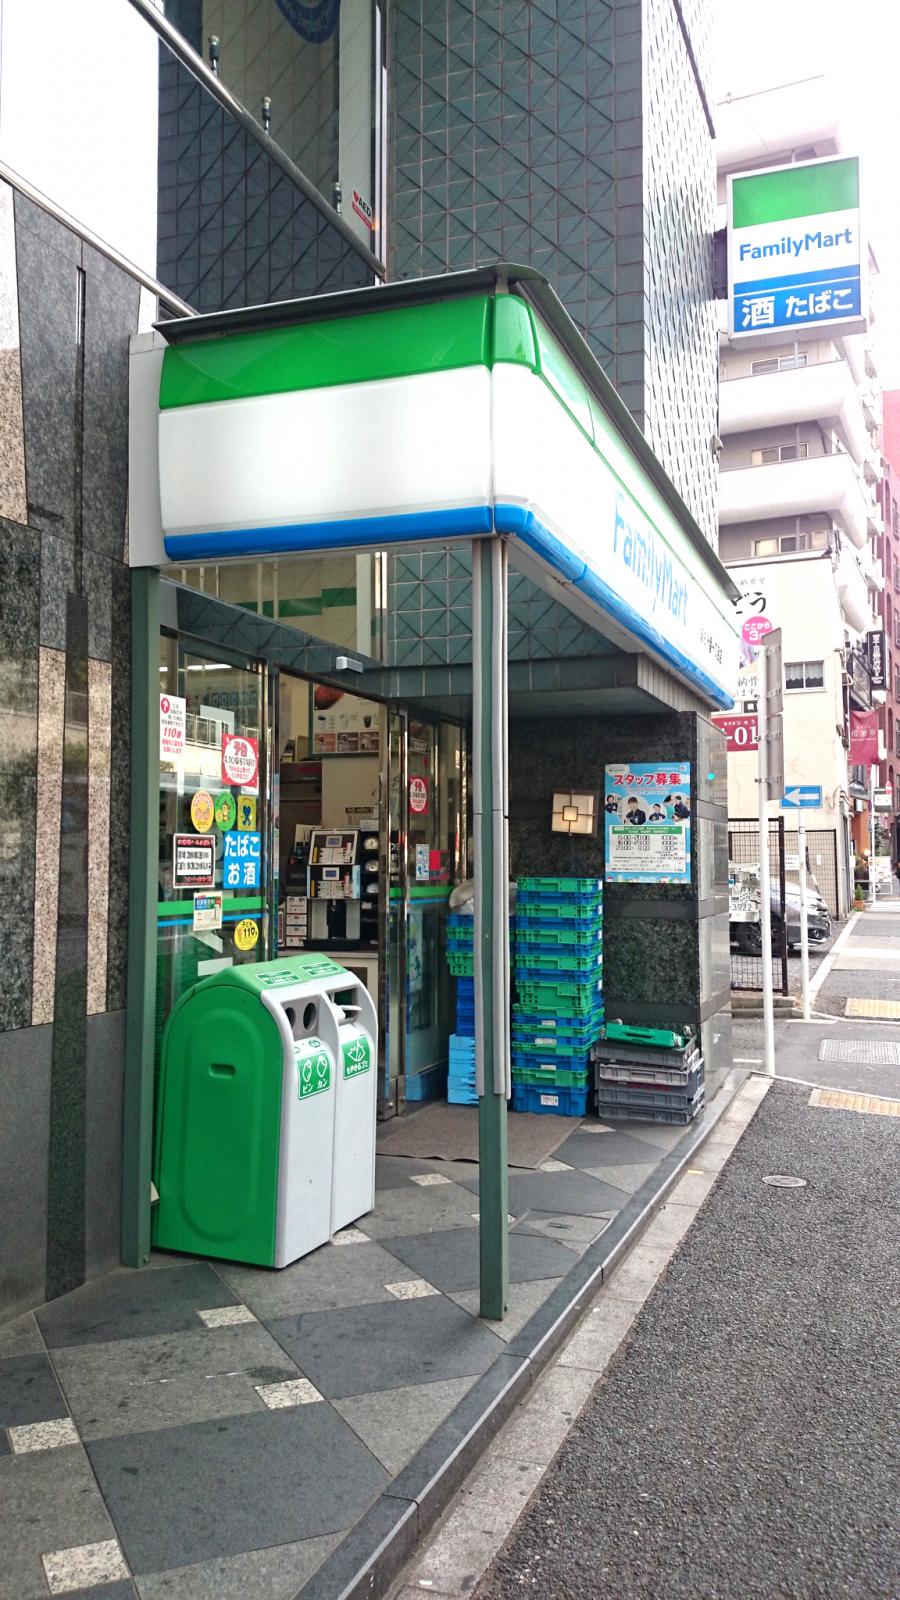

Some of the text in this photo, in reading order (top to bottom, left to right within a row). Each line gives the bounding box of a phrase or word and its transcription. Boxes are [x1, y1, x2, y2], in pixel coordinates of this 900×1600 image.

[358, 197, 371, 216] AED
[739, 228, 853, 262] FamilyMart
[741, 288, 854, 328] 酒 たばこ
[613, 488, 689, 627] FamilyMart
[744, 621, 771, 631] ここから
[613, 772, 682, 786] スタッフ募集
[224, 834, 260, 858] たばこ
[227, 862, 256, 886] お酒
[302, 1078, 328, 1095] ビン カン
